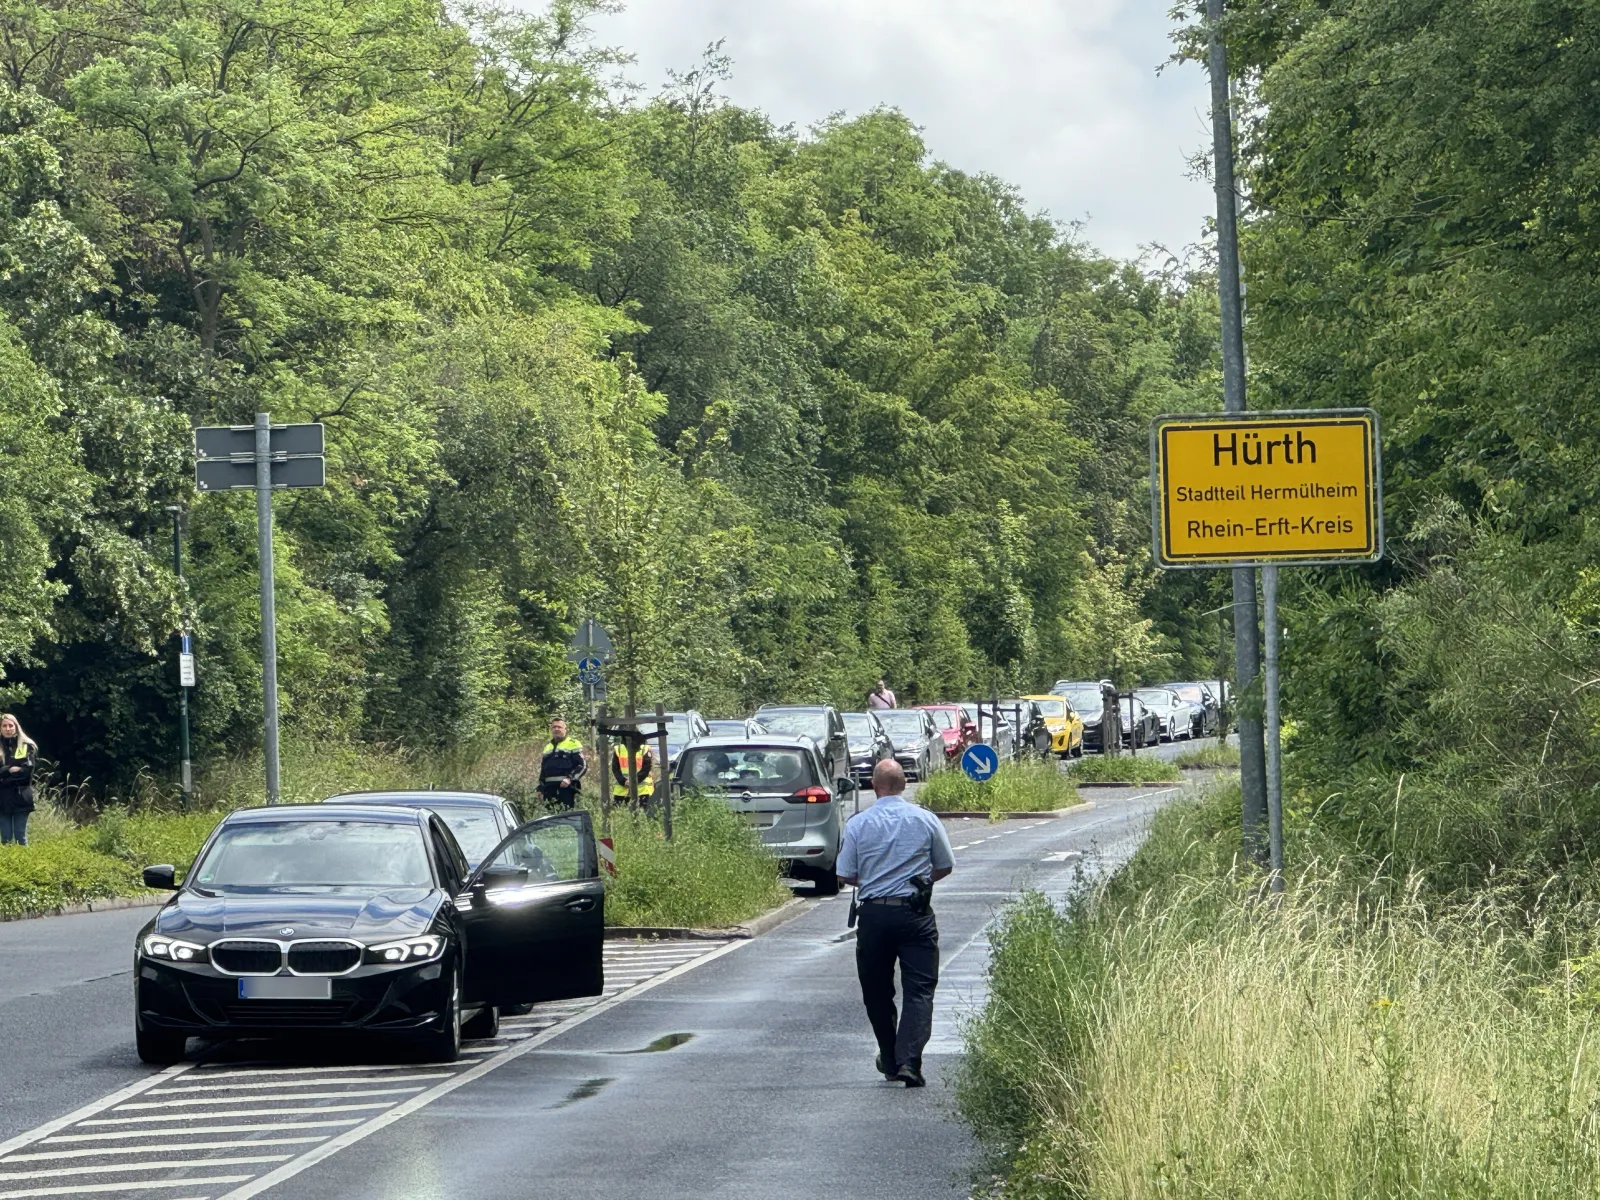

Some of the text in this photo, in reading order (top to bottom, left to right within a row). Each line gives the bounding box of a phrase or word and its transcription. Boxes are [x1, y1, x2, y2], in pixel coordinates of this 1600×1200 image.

[1213, 431, 1317, 466] Hürth
[1176, 482, 1358, 502] Stadtteil Hermülheim
[1187, 515, 1354, 539] Rhein-Erft-Kreis
